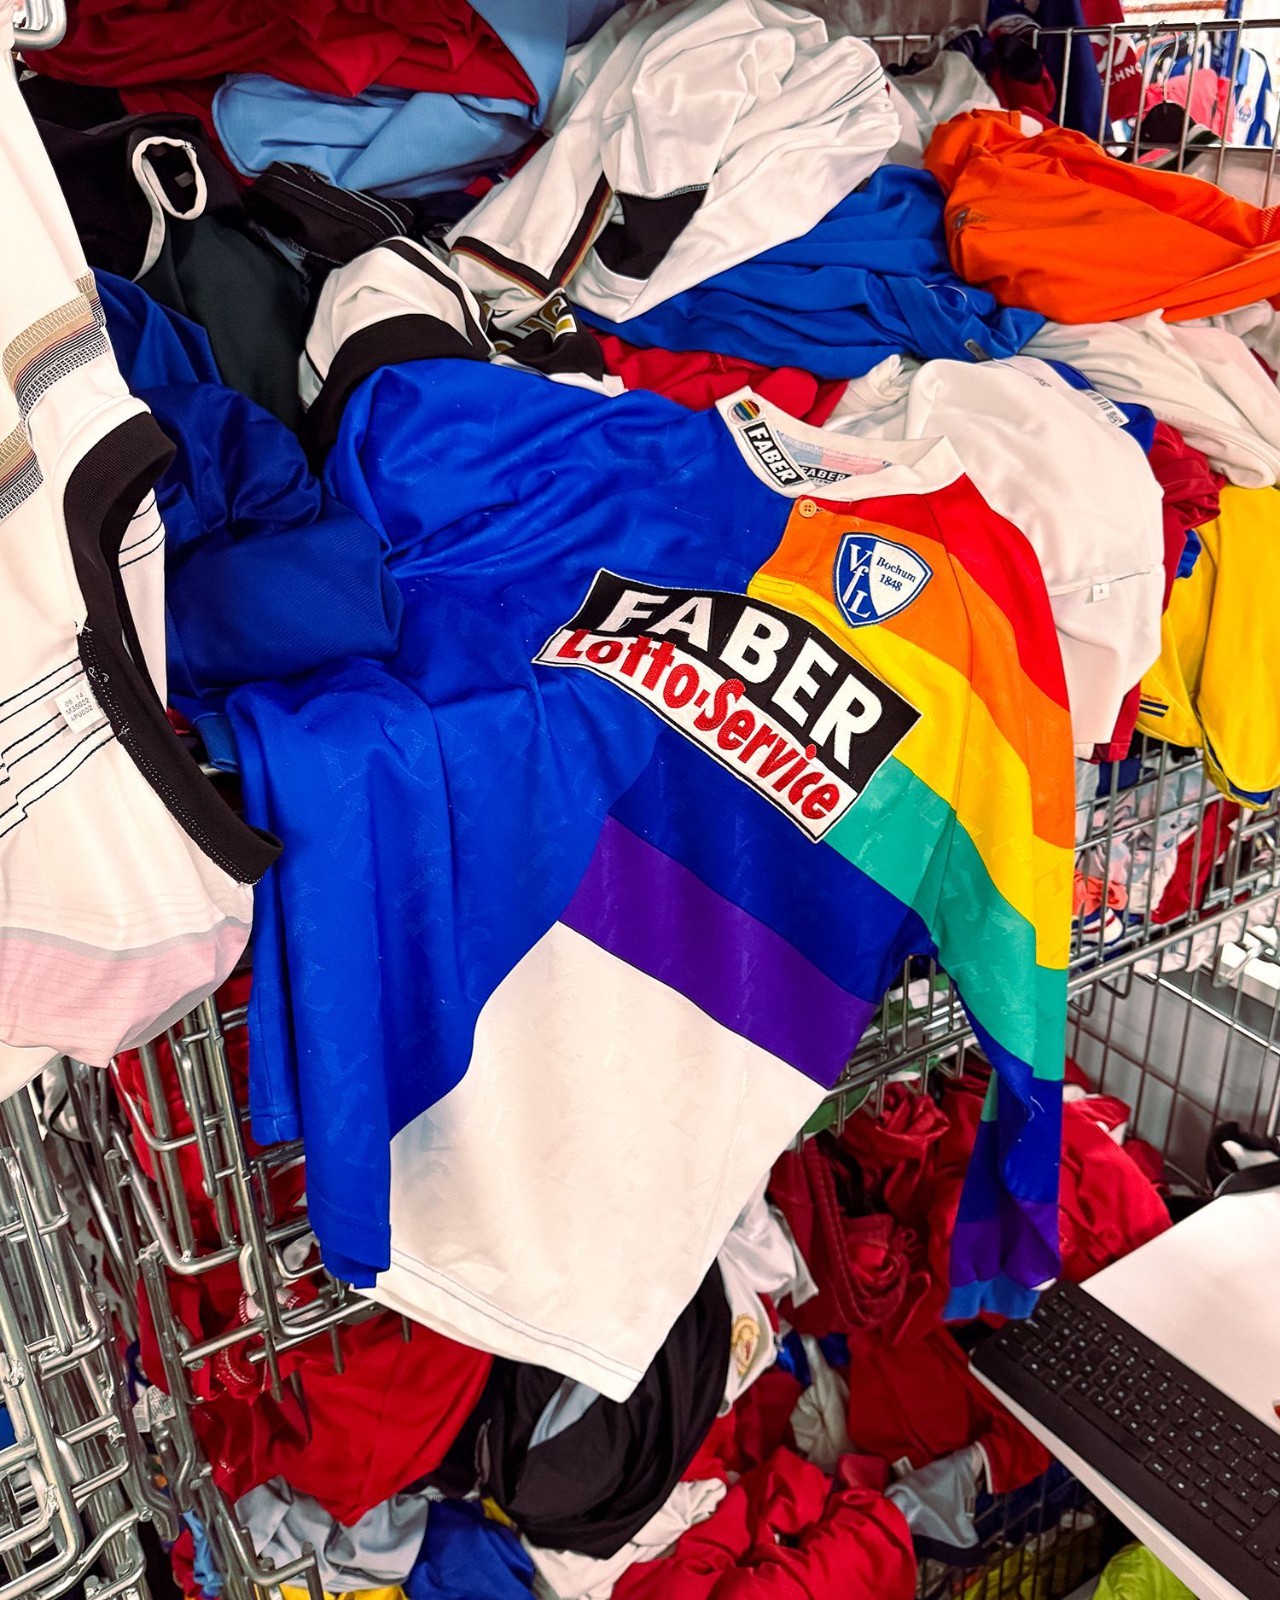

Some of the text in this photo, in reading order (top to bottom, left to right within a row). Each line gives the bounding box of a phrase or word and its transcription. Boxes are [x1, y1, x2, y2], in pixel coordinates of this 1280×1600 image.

[748, 427, 798, 482] FABER
[801, 467, 846, 482] FABER
[842, 544, 873, 618] VfL
[876, 557, 916, 582] Bochum
[880, 574, 903, 592] 1848
[595, 589, 883, 770] FABER
